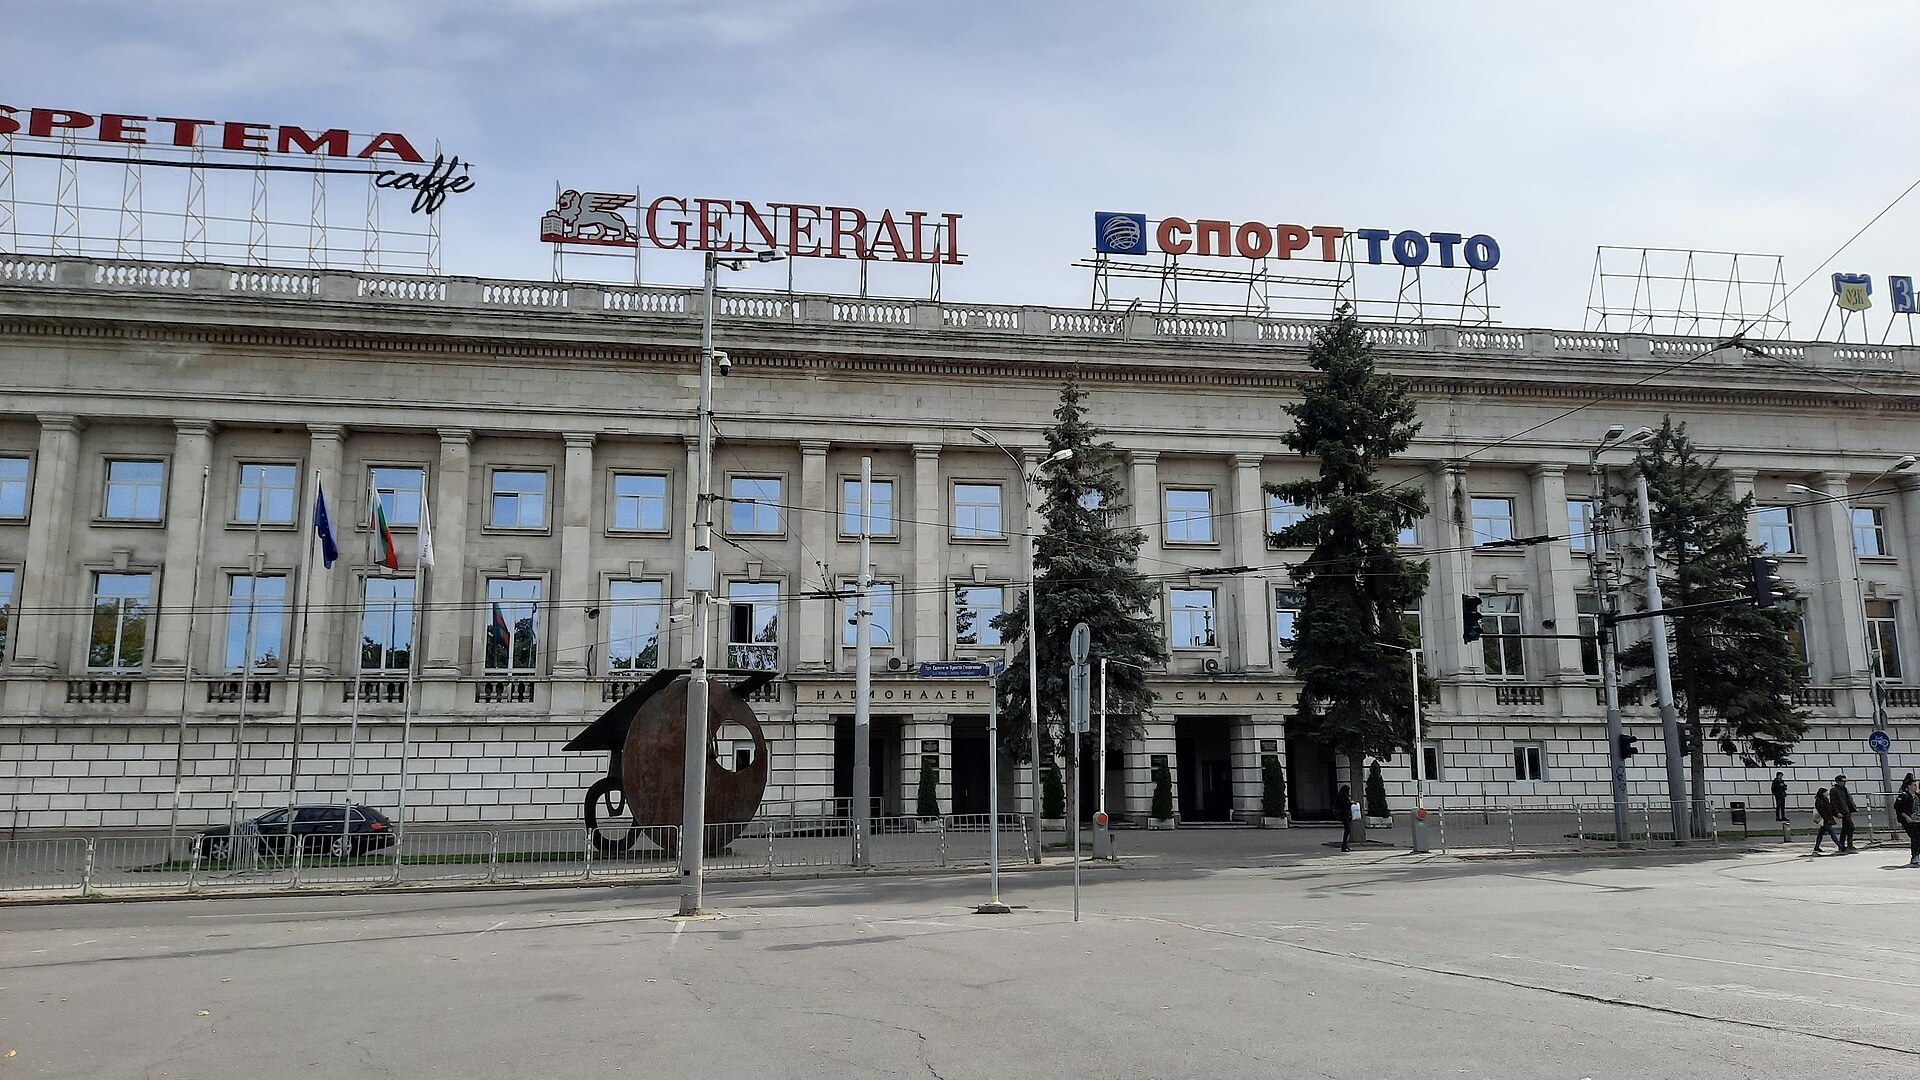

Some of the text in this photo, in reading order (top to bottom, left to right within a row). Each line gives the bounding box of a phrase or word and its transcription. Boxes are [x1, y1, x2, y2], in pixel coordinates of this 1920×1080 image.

[645, 196, 964, 265] GENERALI
[1156, 217, 1501, 270] СПОРТ ТОТО
[816, 689, 975, 700] НАЦИОНАЛЕН
